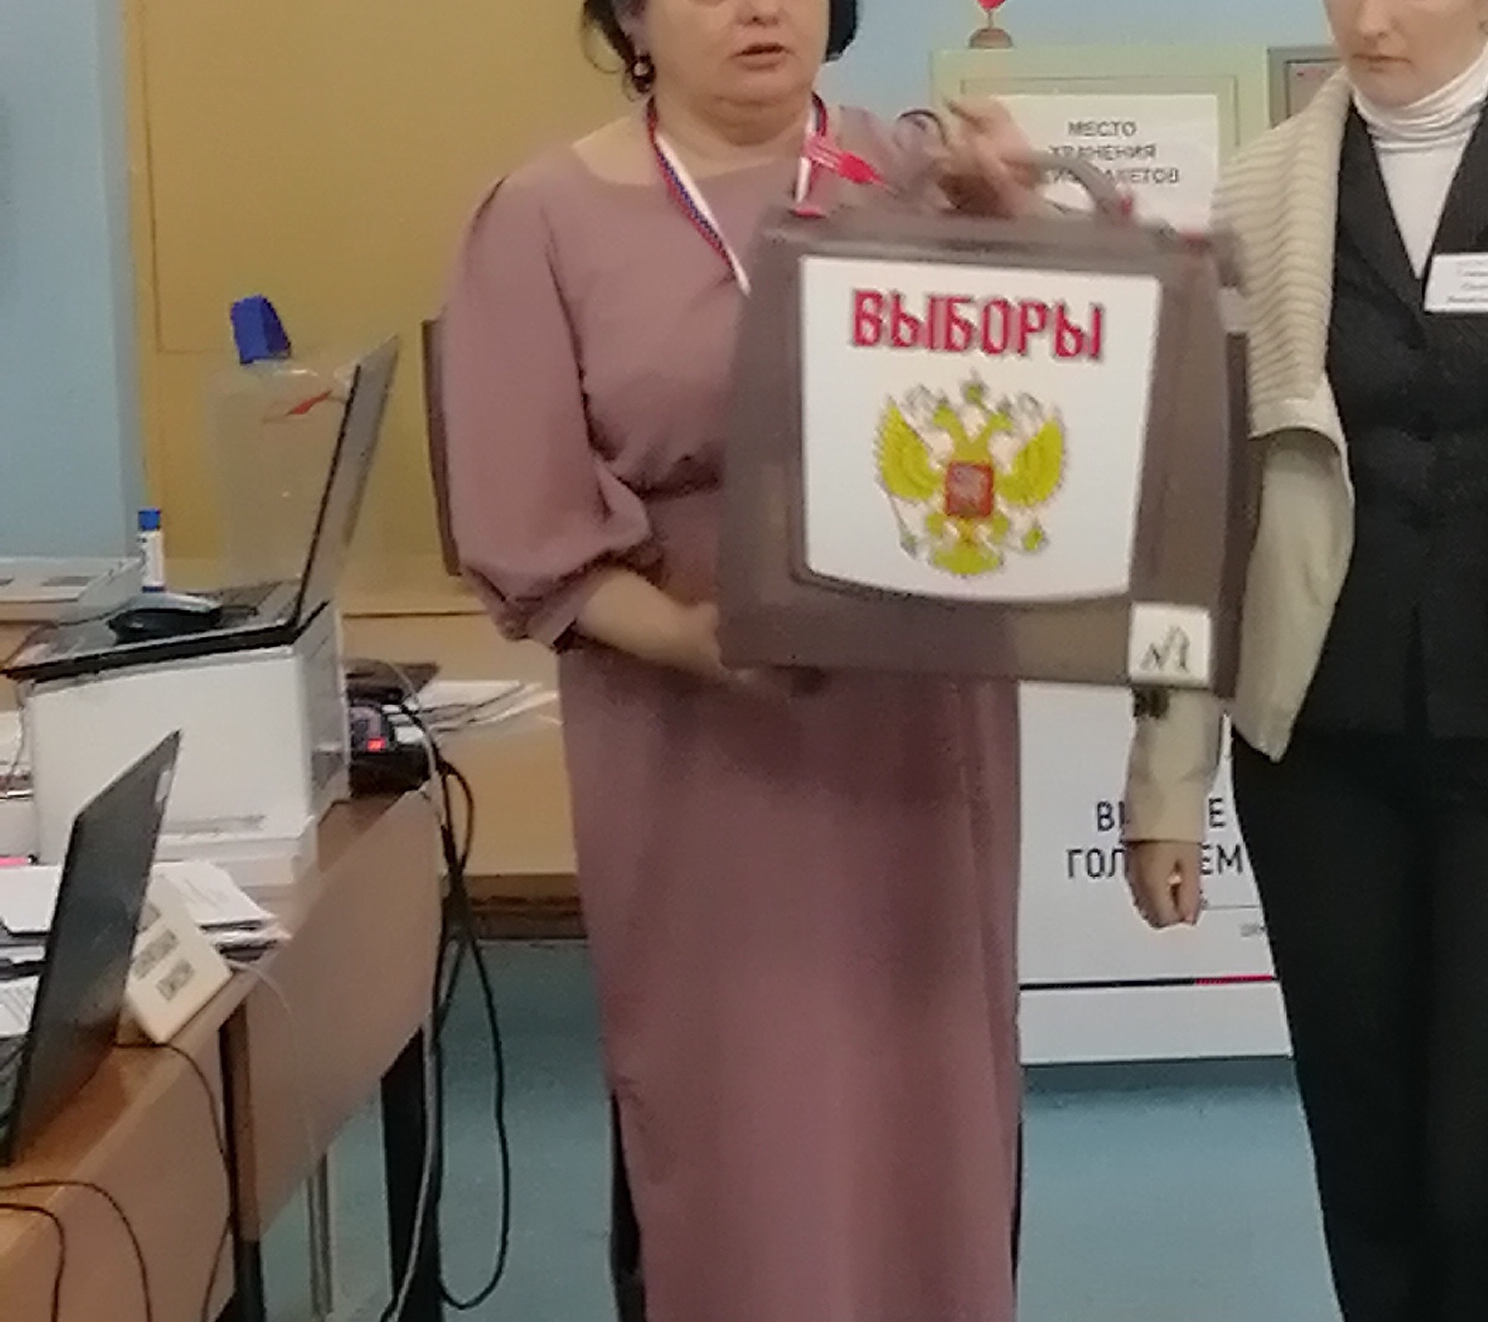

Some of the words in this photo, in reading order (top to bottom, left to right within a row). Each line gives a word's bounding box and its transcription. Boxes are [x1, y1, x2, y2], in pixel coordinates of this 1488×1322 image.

[1067, 120, 1137, 137] МЕСТО
[852, 288, 1105, 361] ВЫБОРЫ
[1066, 843, 1244, 880] ГОЛЕМ
